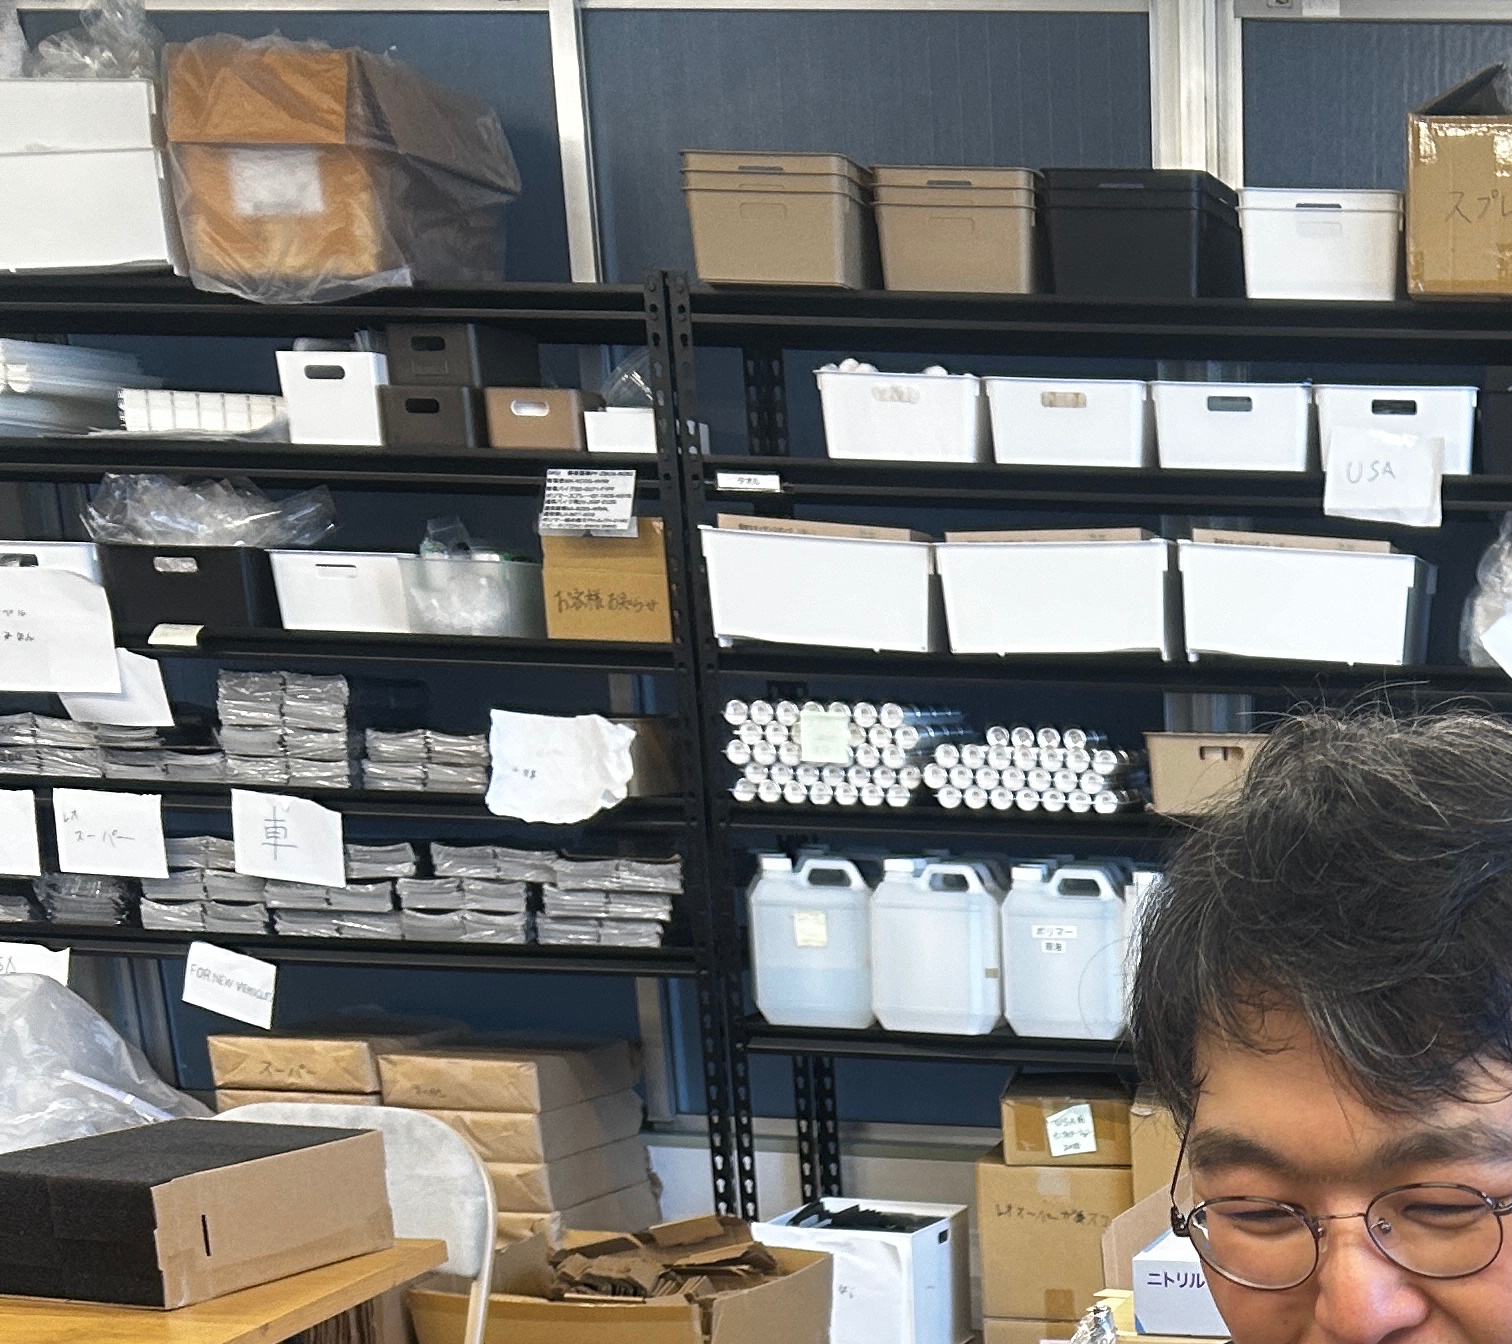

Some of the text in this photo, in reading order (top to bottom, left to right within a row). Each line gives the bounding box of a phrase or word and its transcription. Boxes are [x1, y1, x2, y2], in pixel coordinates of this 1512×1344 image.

[1345, 460, 1396, 484] USA
[261, 806, 298, 861] 車
[190, 963, 212, 982] FOR
[1147, 1271, 1206, 1289] ニトリル
